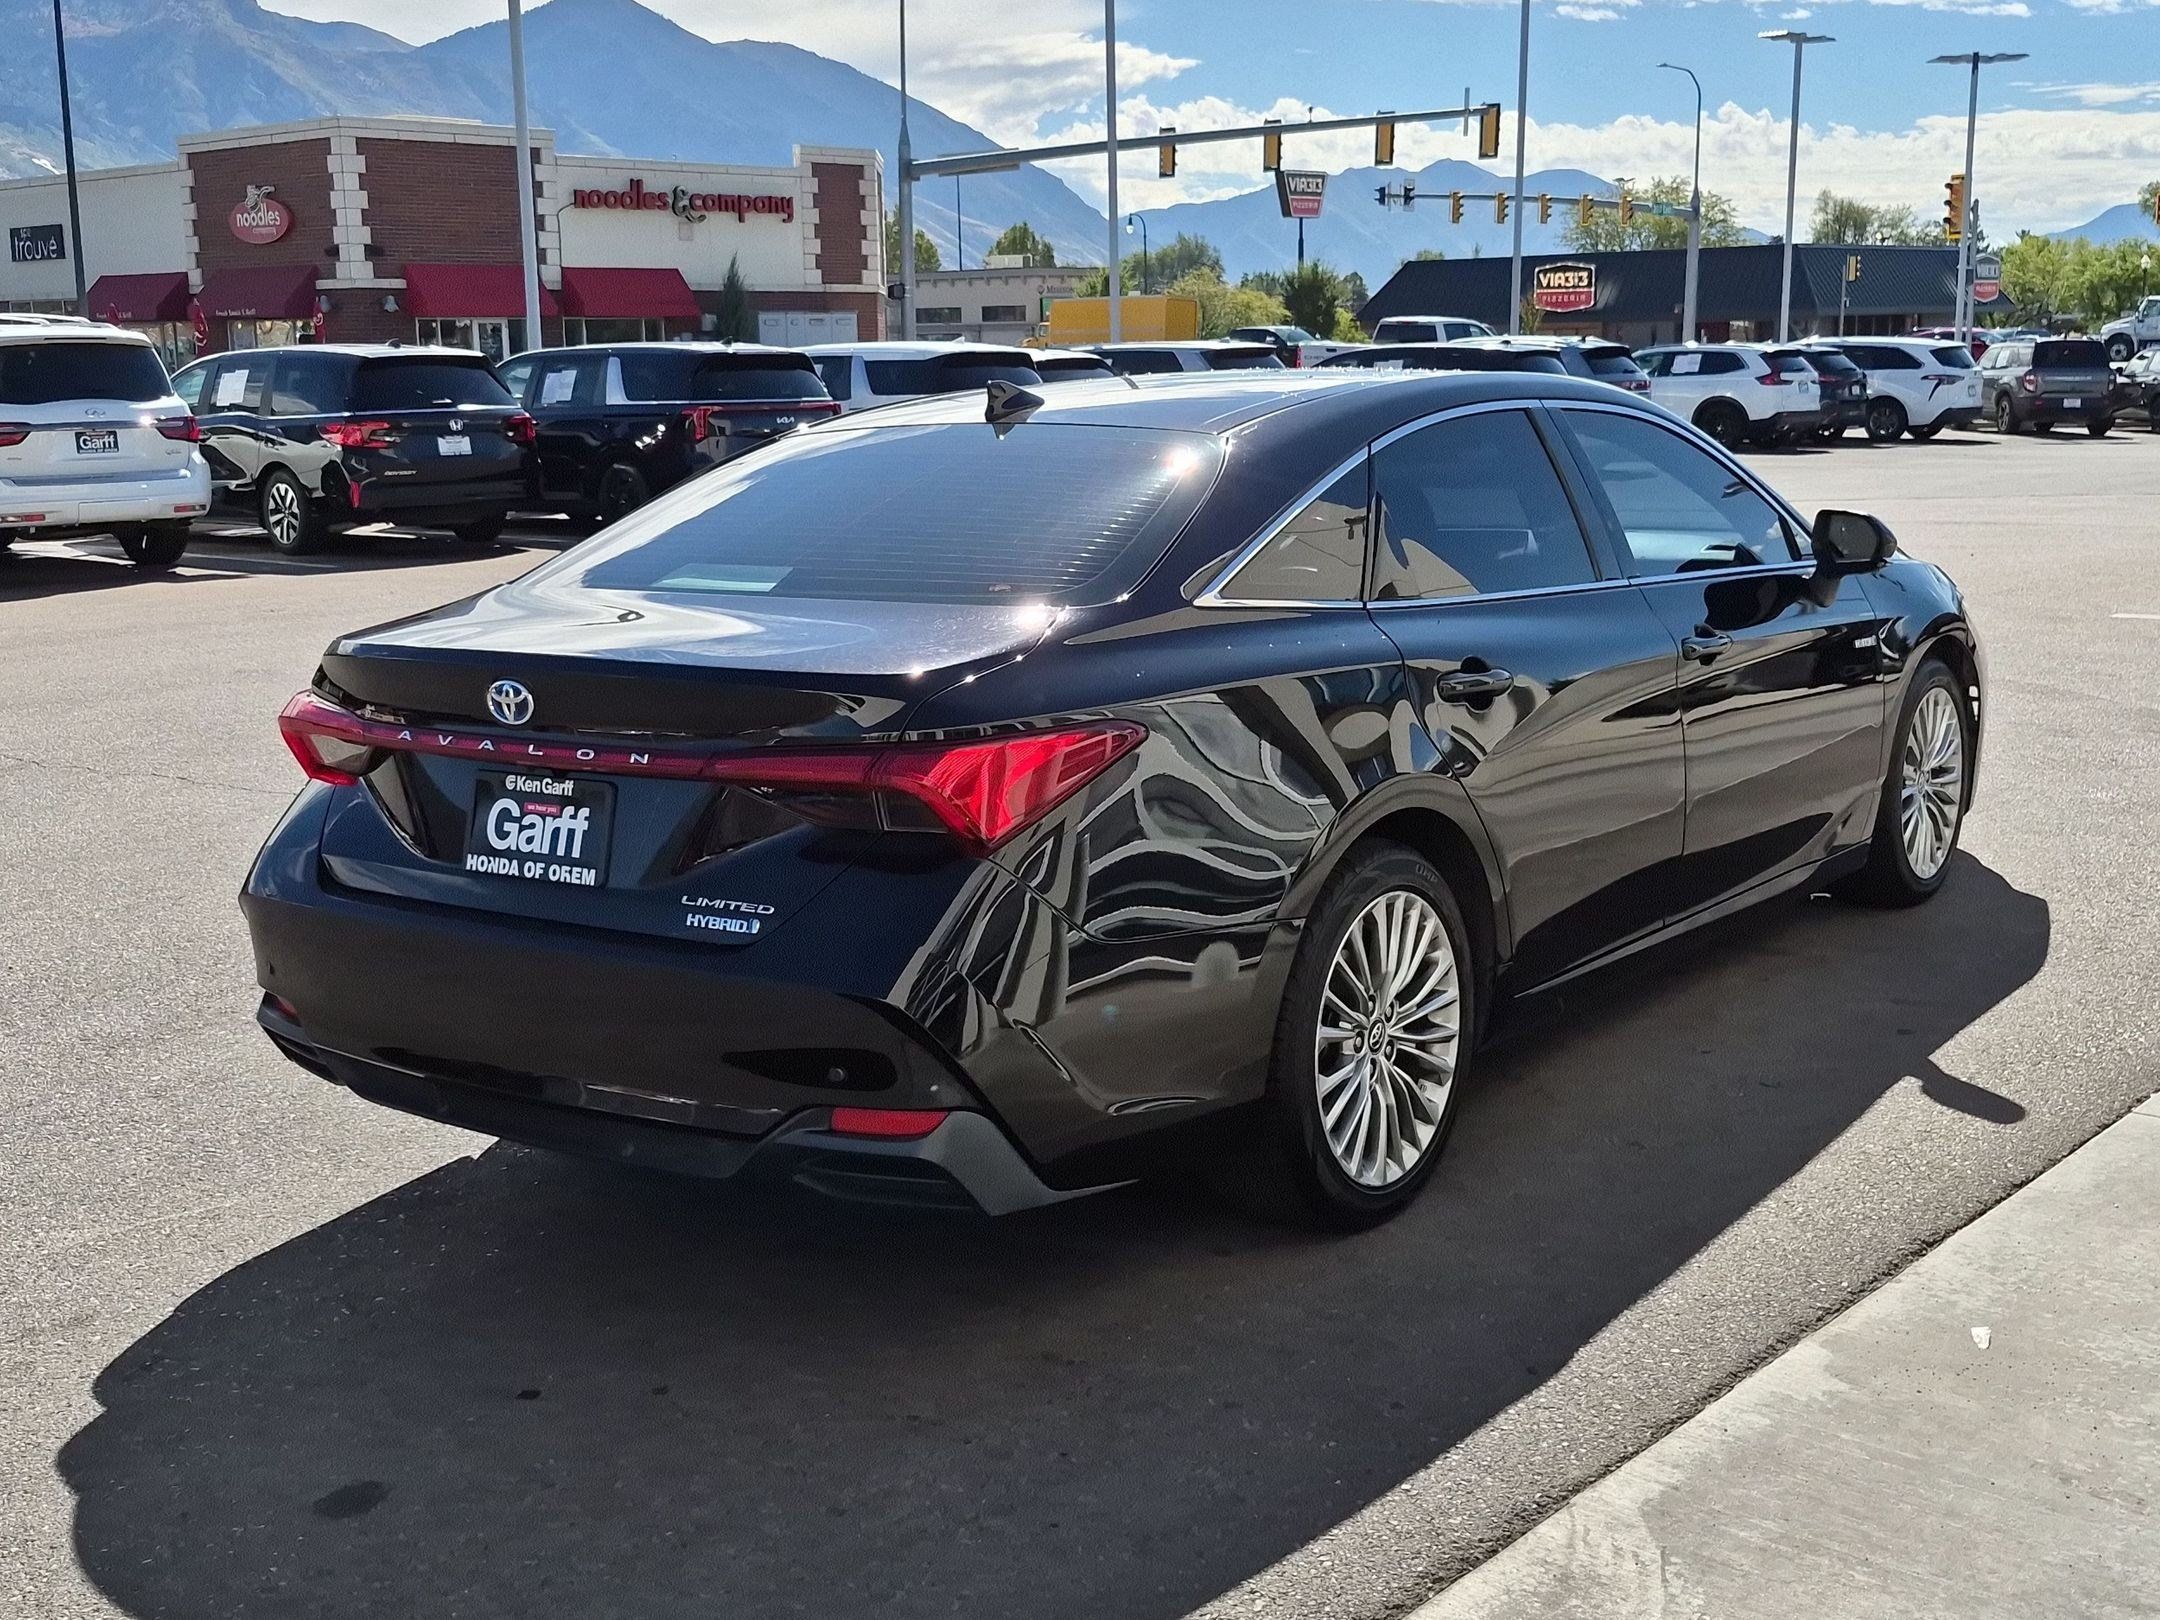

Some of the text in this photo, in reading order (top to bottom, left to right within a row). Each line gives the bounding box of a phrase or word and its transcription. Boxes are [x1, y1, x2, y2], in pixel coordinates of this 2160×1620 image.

[1289, 177, 1323, 192] VIA313
[575, 178, 669, 210] noodles
[689, 194, 794, 223] company
[236, 202, 280, 227] noodles
[1539, 271, 1588, 287] VIA313
[80, 435, 114, 449] Garff
[398, 730, 649, 765] AVALON
[516, 775, 574, 797] Ken Garff
[486, 798, 590, 858] Garff
[465, 853, 597, 887] HONDA OF OREM
[681, 895, 775, 914] LIMITED
[686, 913, 749, 934] HYBRID
